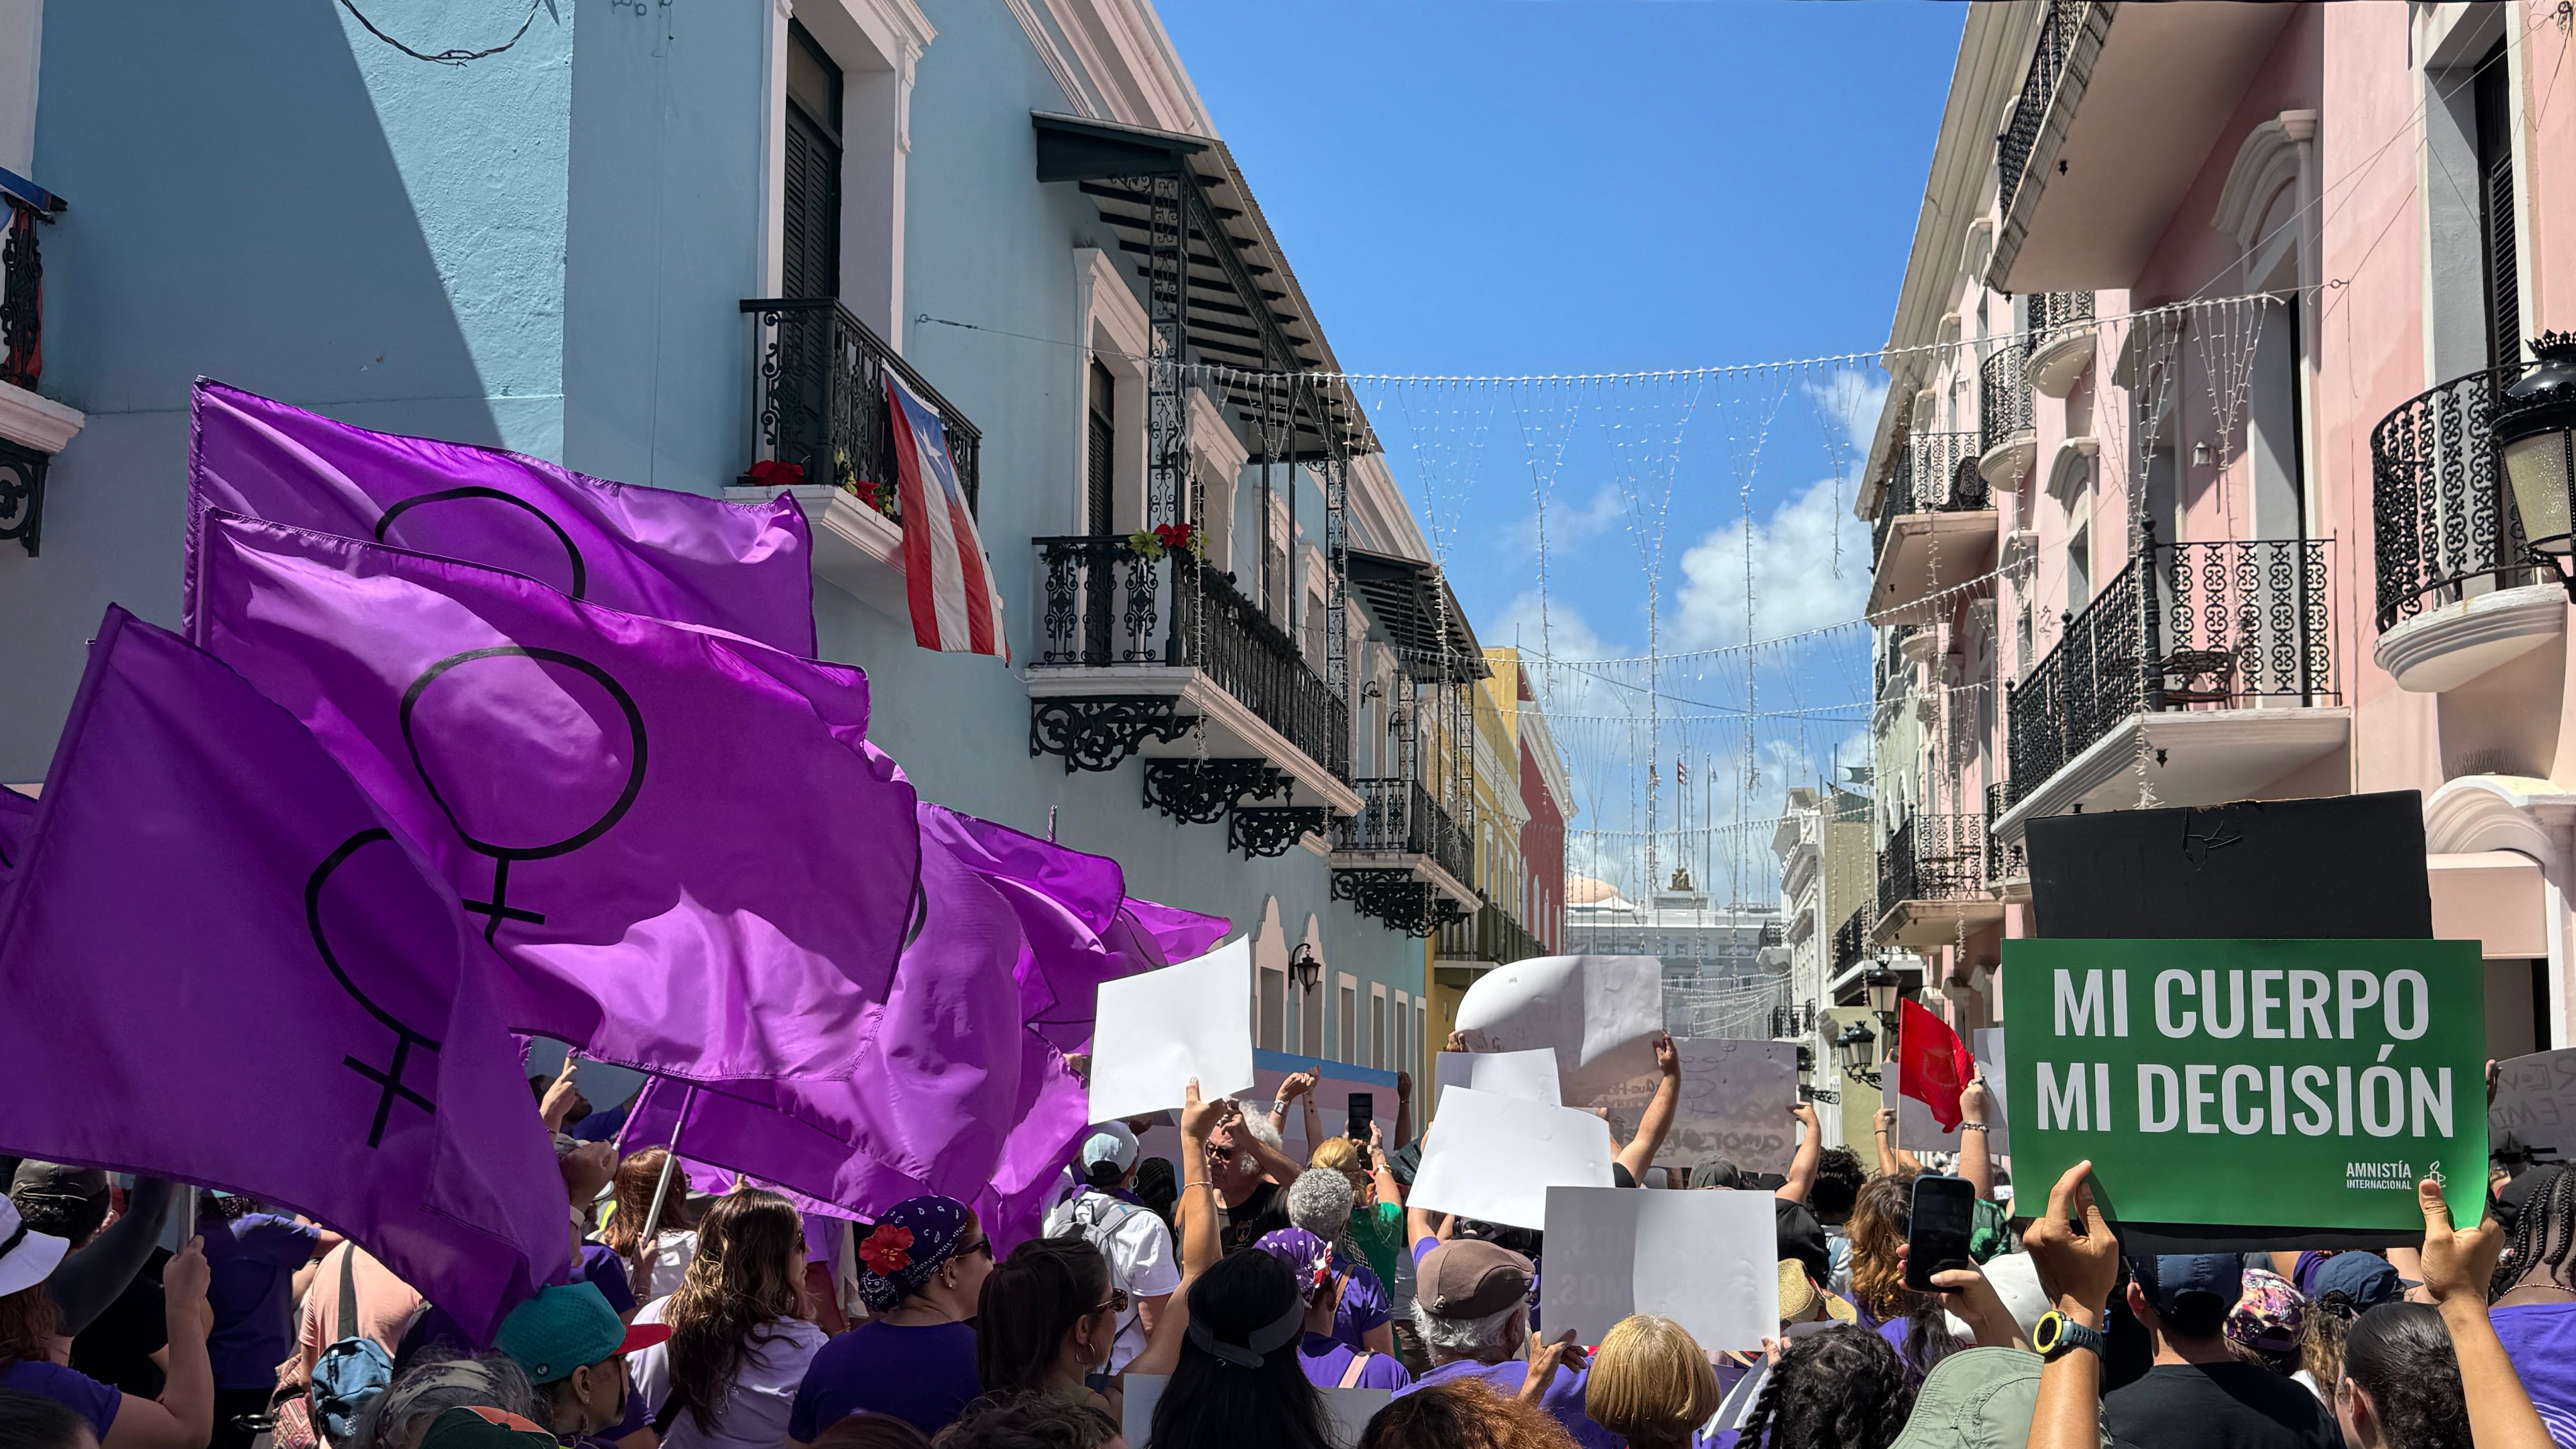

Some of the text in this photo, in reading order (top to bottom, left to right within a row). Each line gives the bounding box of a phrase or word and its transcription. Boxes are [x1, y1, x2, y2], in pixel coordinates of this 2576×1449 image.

[2054, 968, 2429, 1041] MI CUERPO
[2037, 1044, 2453, 1138] MI DECISIÓN
[2346, 1160, 2412, 1179] AMNISTÍA
[2346, 1179, 2412, 1190] INTERNACIONAL
